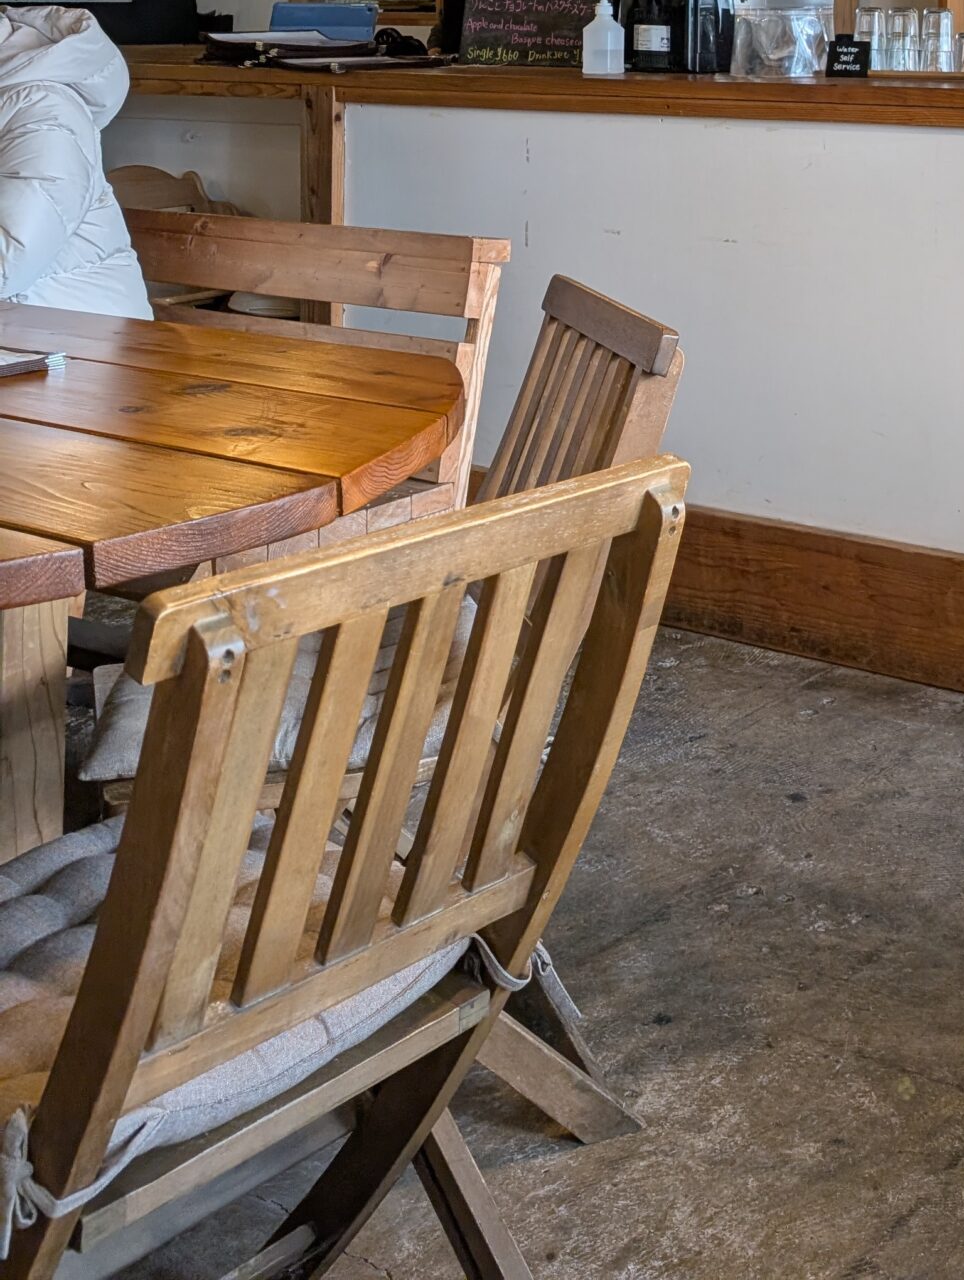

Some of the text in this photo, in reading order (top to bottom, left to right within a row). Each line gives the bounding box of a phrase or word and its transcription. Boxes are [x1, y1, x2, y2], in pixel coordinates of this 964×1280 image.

[466, 16, 537, 32] Apple and chocolate
[512, 33, 542, 47] Basque
[467, 47, 494, 61] Single
[840, 54, 855, 62] Self
[833, 62, 860, 71] Service
